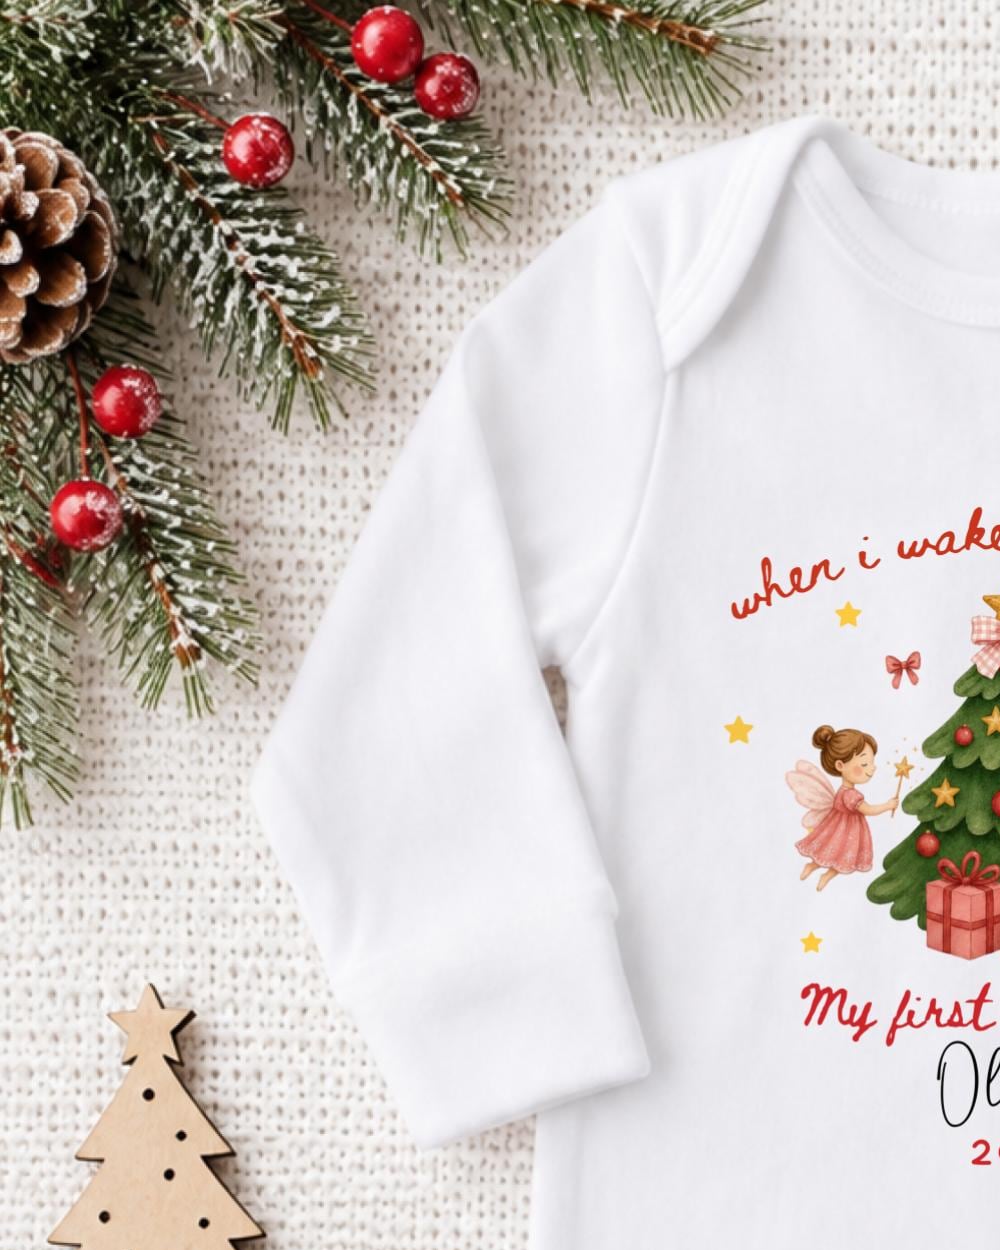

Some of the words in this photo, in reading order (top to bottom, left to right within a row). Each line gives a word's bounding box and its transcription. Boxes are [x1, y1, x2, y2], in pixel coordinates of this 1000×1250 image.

[731, 557, 846, 620] when
[858, 536, 881, 570] i
[800, 982, 878, 1043] My
[885, 982, 997, 1046] first
